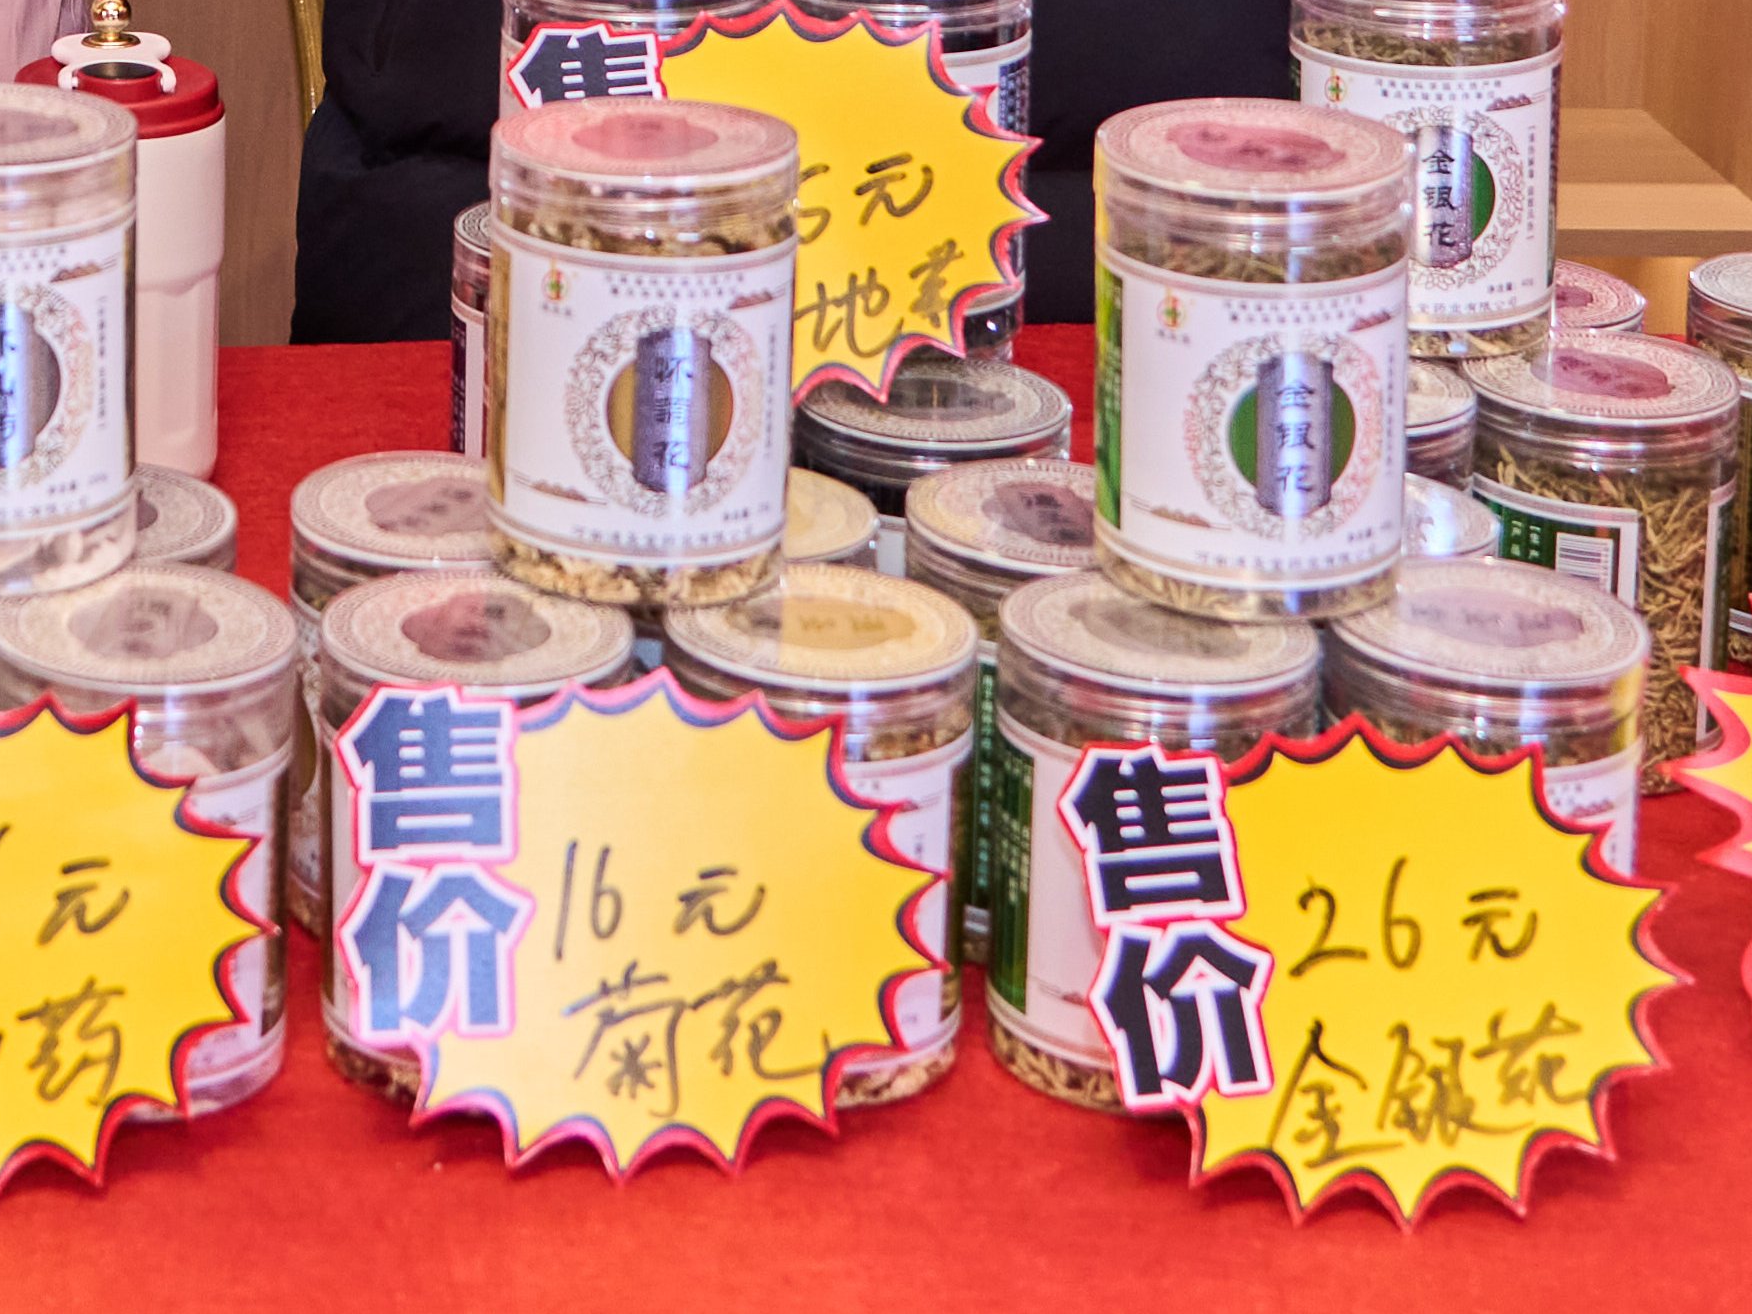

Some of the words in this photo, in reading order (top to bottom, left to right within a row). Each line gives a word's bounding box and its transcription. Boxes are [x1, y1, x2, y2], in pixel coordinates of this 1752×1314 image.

[1420, 148, 1458, 248] 金银花
[1275, 379, 1316, 493] 金银花
[351, 696, 524, 1033] 售价
[555, 838, 767, 963] 16元
[1070, 751, 1262, 1098] 售价
[1287, 855, 1540, 979] 26元
[561, 957, 832, 1120] 菊花
